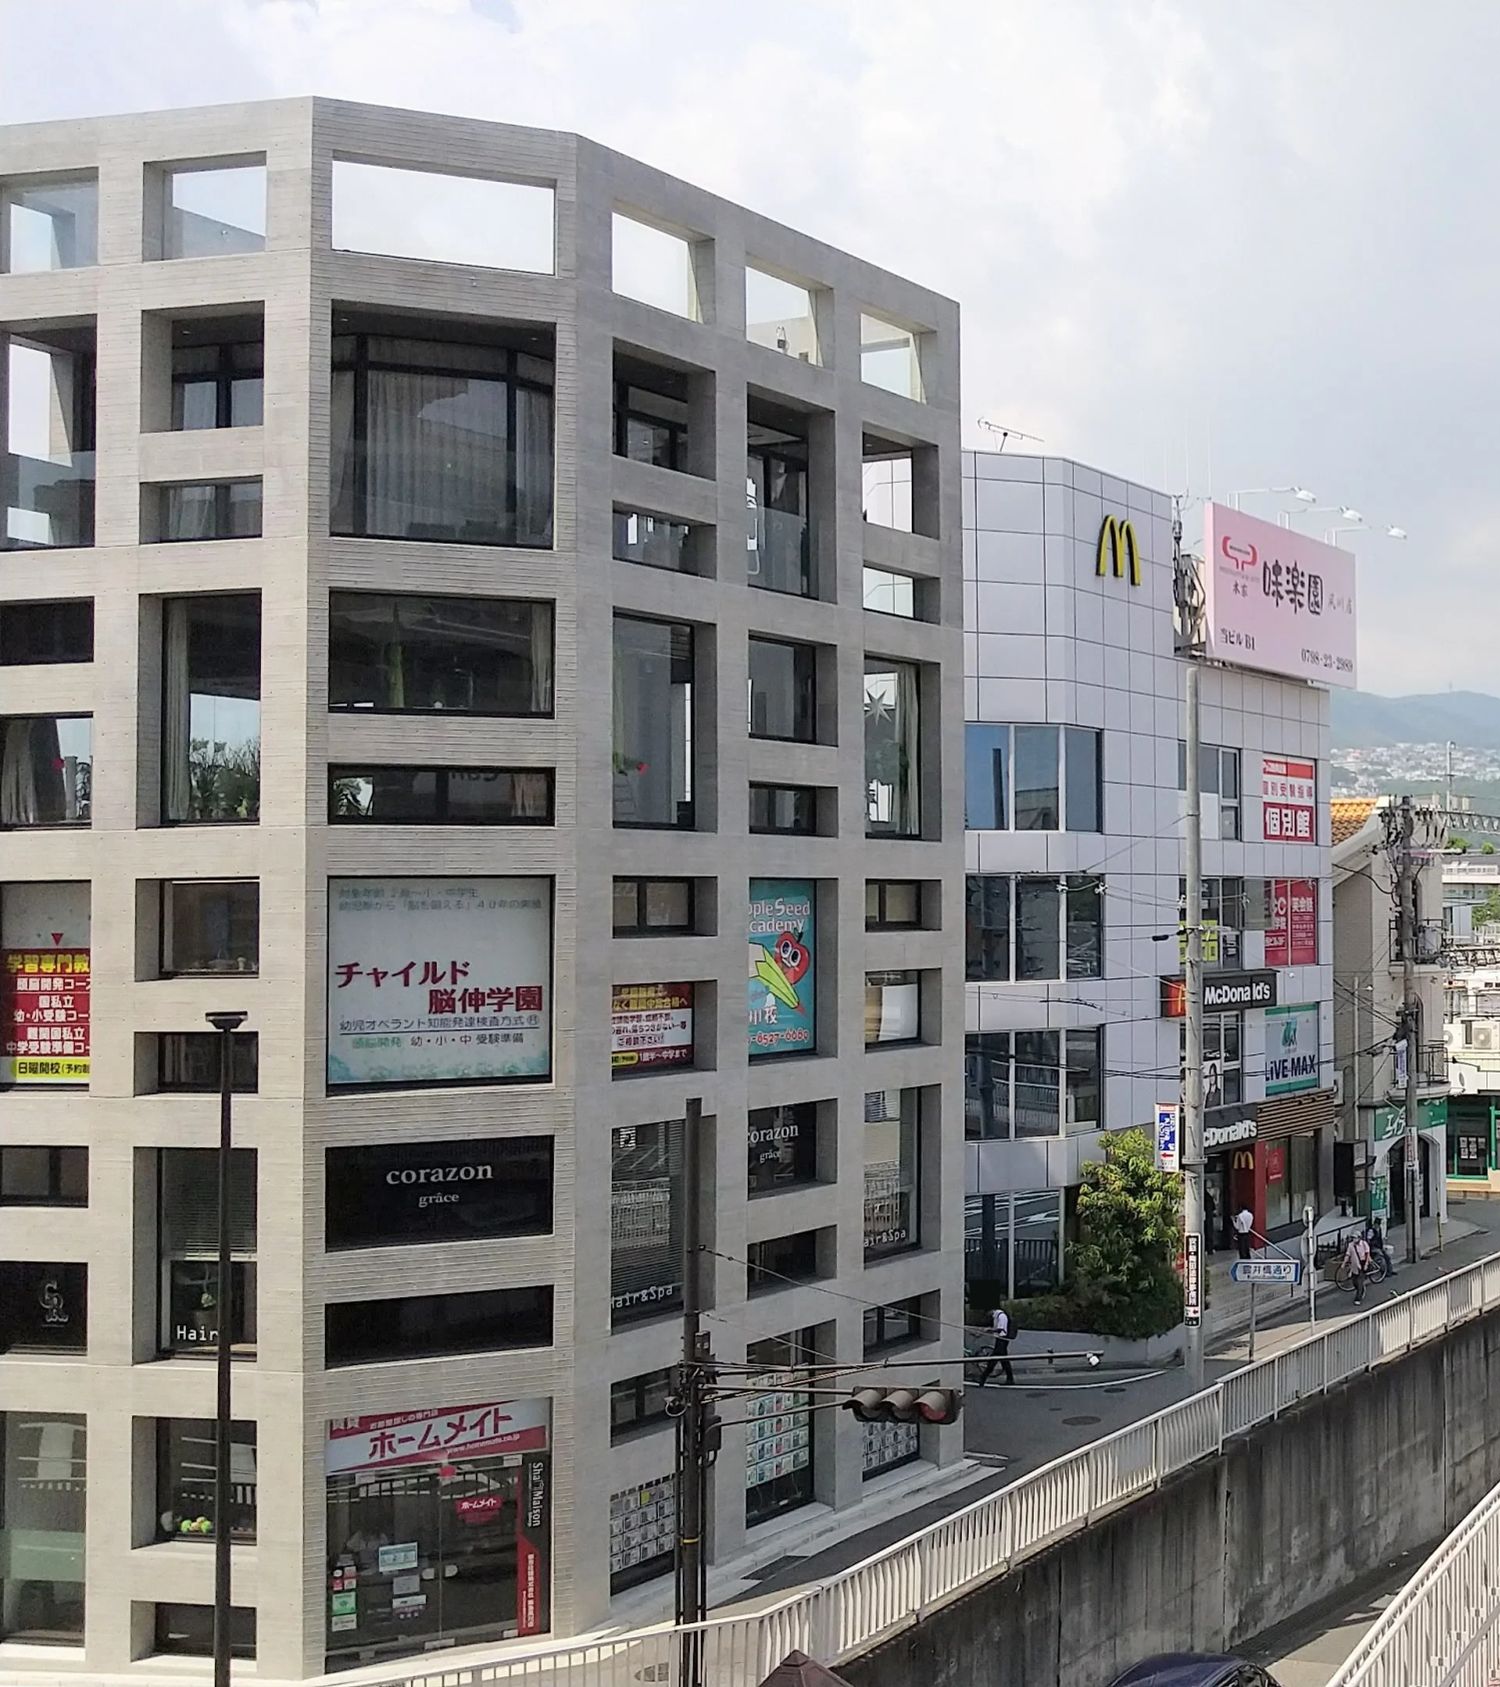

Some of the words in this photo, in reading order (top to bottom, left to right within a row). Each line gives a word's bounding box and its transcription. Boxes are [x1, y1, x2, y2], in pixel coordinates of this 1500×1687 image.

[335, 960, 470, 988] チャイルド
[428, 985, 543, 1014] 脳伸学園
[1204, 982, 1270, 1005] McDonald's
[386, 1161, 494, 1185] corazon
[418, 1188, 460, 1208] grâce
[176, 1325, 219, 1341] Hair
[368, 1407, 513, 1459] ホームメイト
[460, 1498, 497, 1510] ホームメイト
